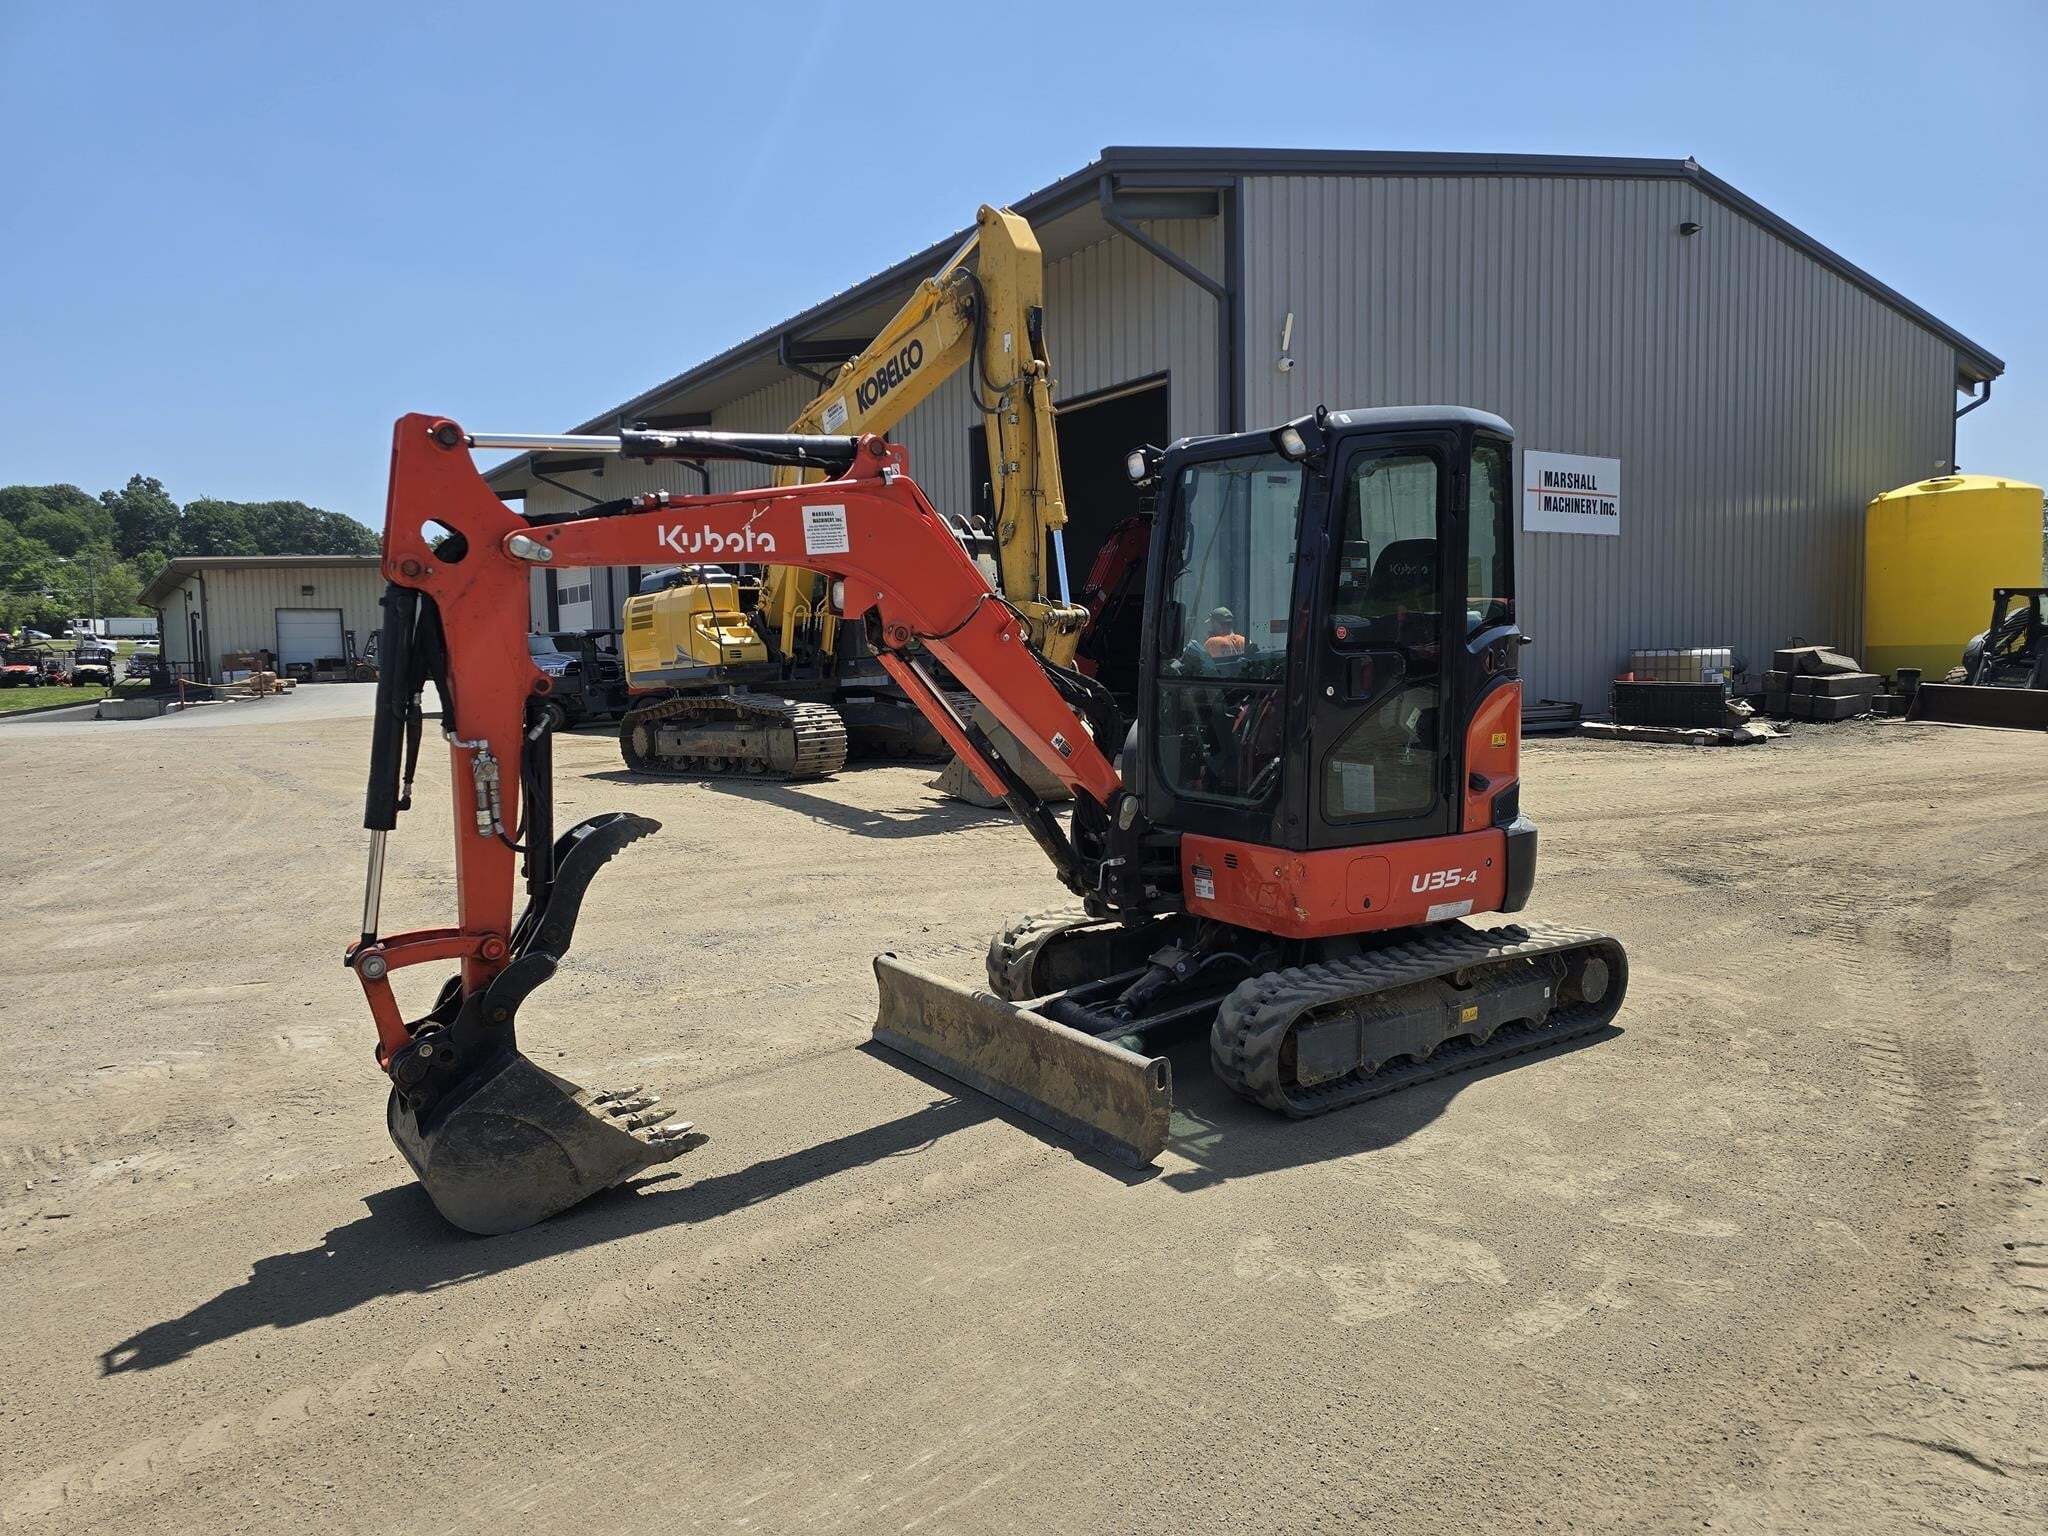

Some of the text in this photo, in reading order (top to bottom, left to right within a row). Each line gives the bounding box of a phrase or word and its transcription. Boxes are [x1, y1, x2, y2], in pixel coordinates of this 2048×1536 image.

[855, 339, 923, 414] KOBELCO
[1544, 471, 1598, 490] MARSHALL
[1544, 496, 1617, 516] MACHINERY, Inc.
[657, 525, 776, 554] Kubota
[1390, 563, 1429, 576] Kuboa
[1411, 868, 1477, 893] U35-4
